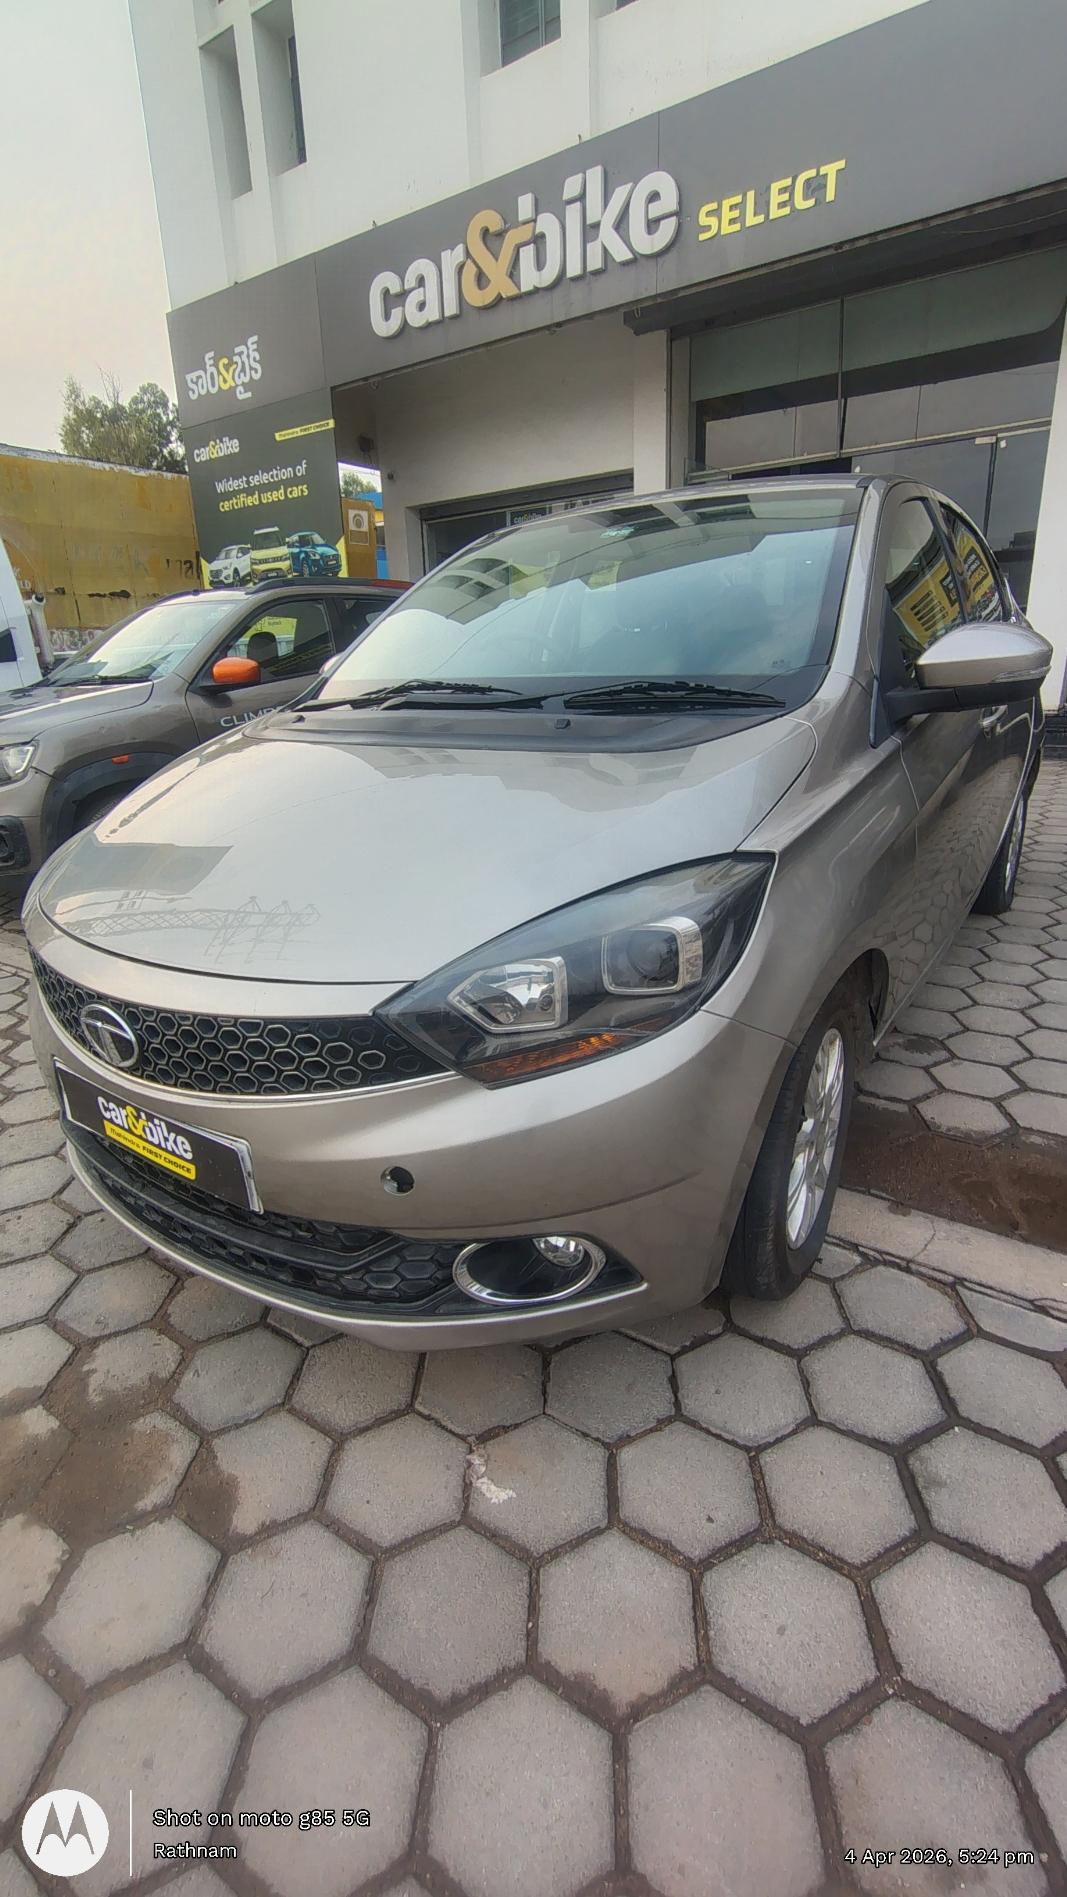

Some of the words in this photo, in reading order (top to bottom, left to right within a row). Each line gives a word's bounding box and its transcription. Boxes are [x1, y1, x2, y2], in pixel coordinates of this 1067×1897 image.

[369, 165, 680, 339] car&bike
[698, 159, 846, 242] SELECT
[193, 436, 240, 463] car&bike
[215, 476, 249, 494] Widest
[249, 466, 294, 487] selection
[295, 460, 307, 477] of
[219, 491, 259, 512] certified
[260, 485, 285, 504] used
[286, 484, 309, 499] cars
[97, 1096, 193, 1160] car&bike
[142, 1145, 163, 1160] FIRST
[163, 1156, 192, 1174] CHOICE
